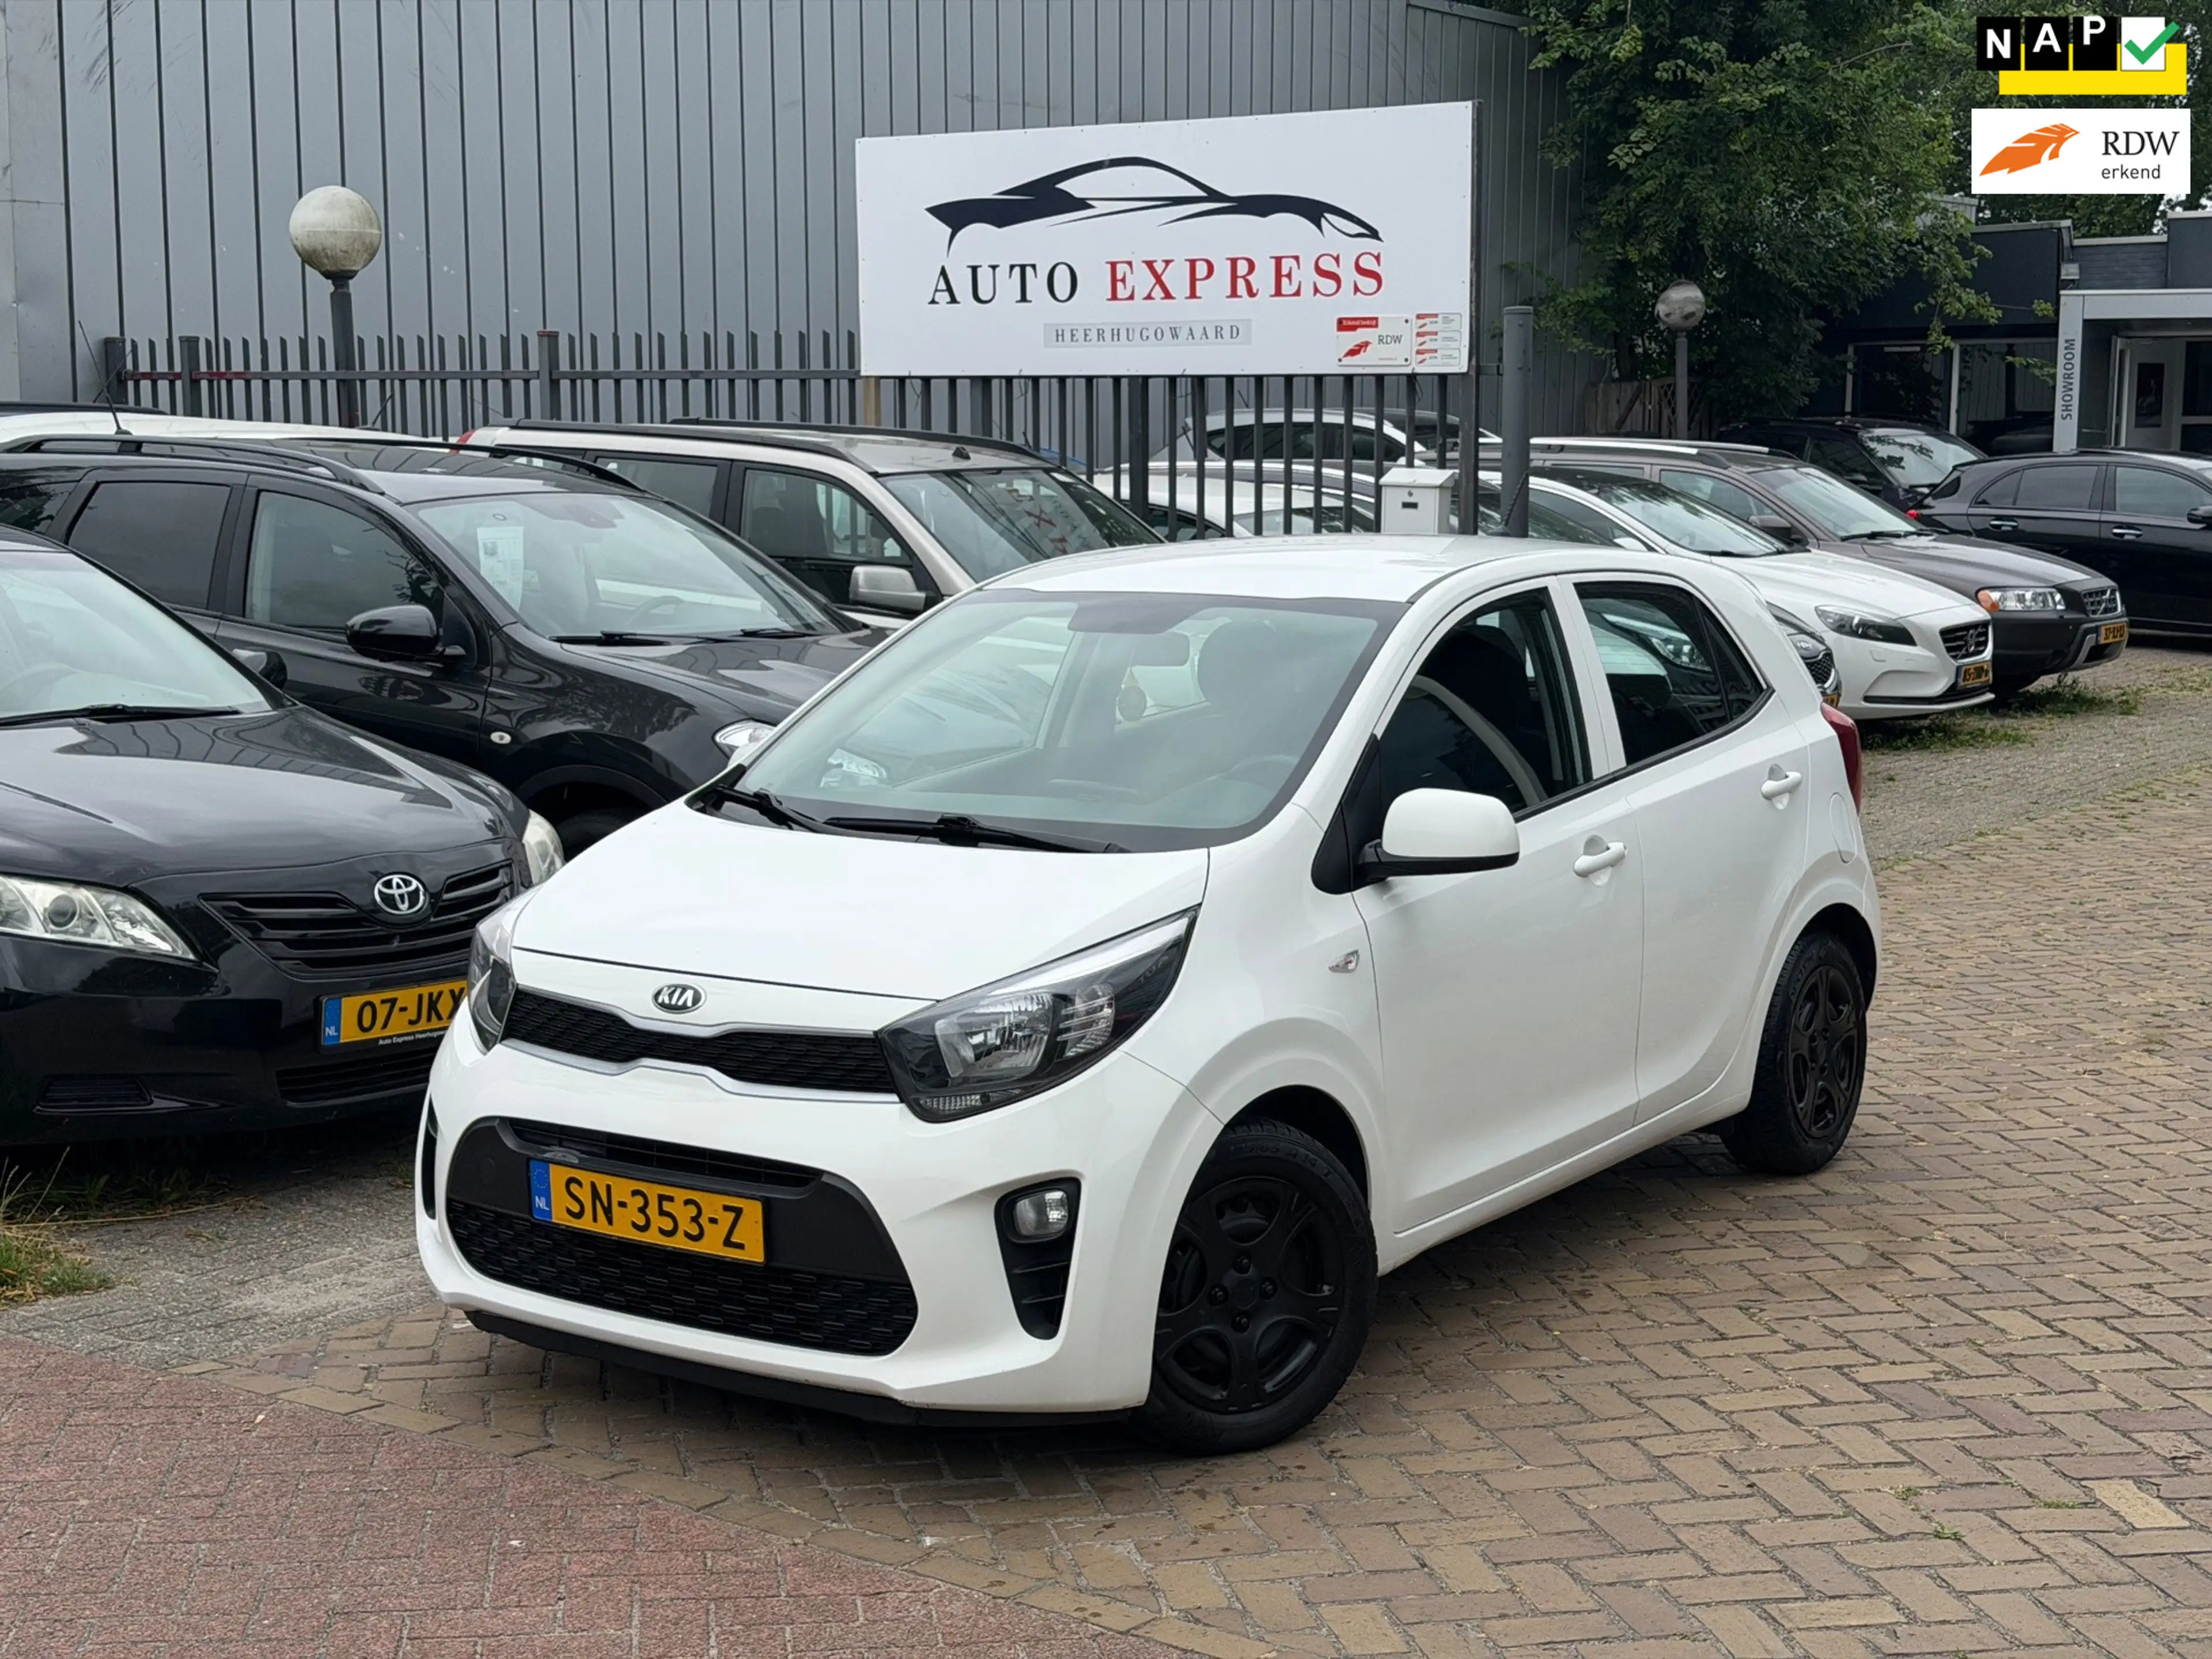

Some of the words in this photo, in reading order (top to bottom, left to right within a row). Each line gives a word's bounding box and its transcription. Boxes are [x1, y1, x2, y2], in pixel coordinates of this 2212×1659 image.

[927, 262, 1078, 305] AUTO
[1105, 252, 1384, 302] EXPRESS
[1055, 324, 1240, 343] HEERHUGOWAARD
[1377, 334, 1403, 344] RDW
[2061, 338, 2075, 421] SHOWROOM
[658, 986, 694, 1007] KIA
[325, 1025, 338, 1036] NL
[535, 1195, 550, 1211] NL
[565, 1176, 745, 1251] SN-353-Z
